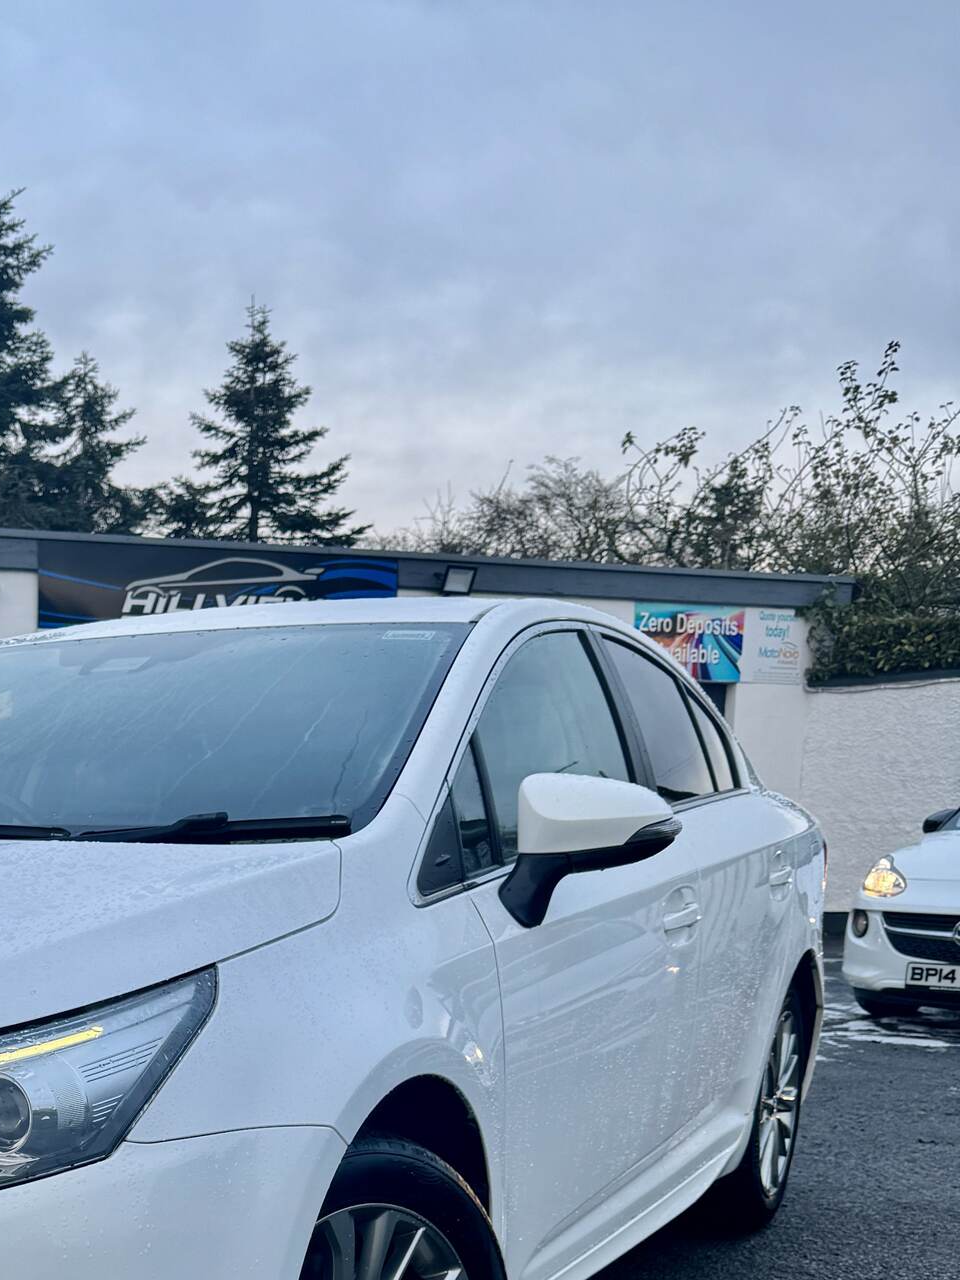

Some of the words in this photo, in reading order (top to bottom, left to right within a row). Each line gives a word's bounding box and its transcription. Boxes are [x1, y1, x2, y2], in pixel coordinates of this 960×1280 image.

[122, 590, 313, 613] HILLV
[640, 612, 672, 632] Zero
[676, 613, 738, 640] Deposits
[674, 643, 720, 665] ailable
[910, 966, 957, 984] BP14
